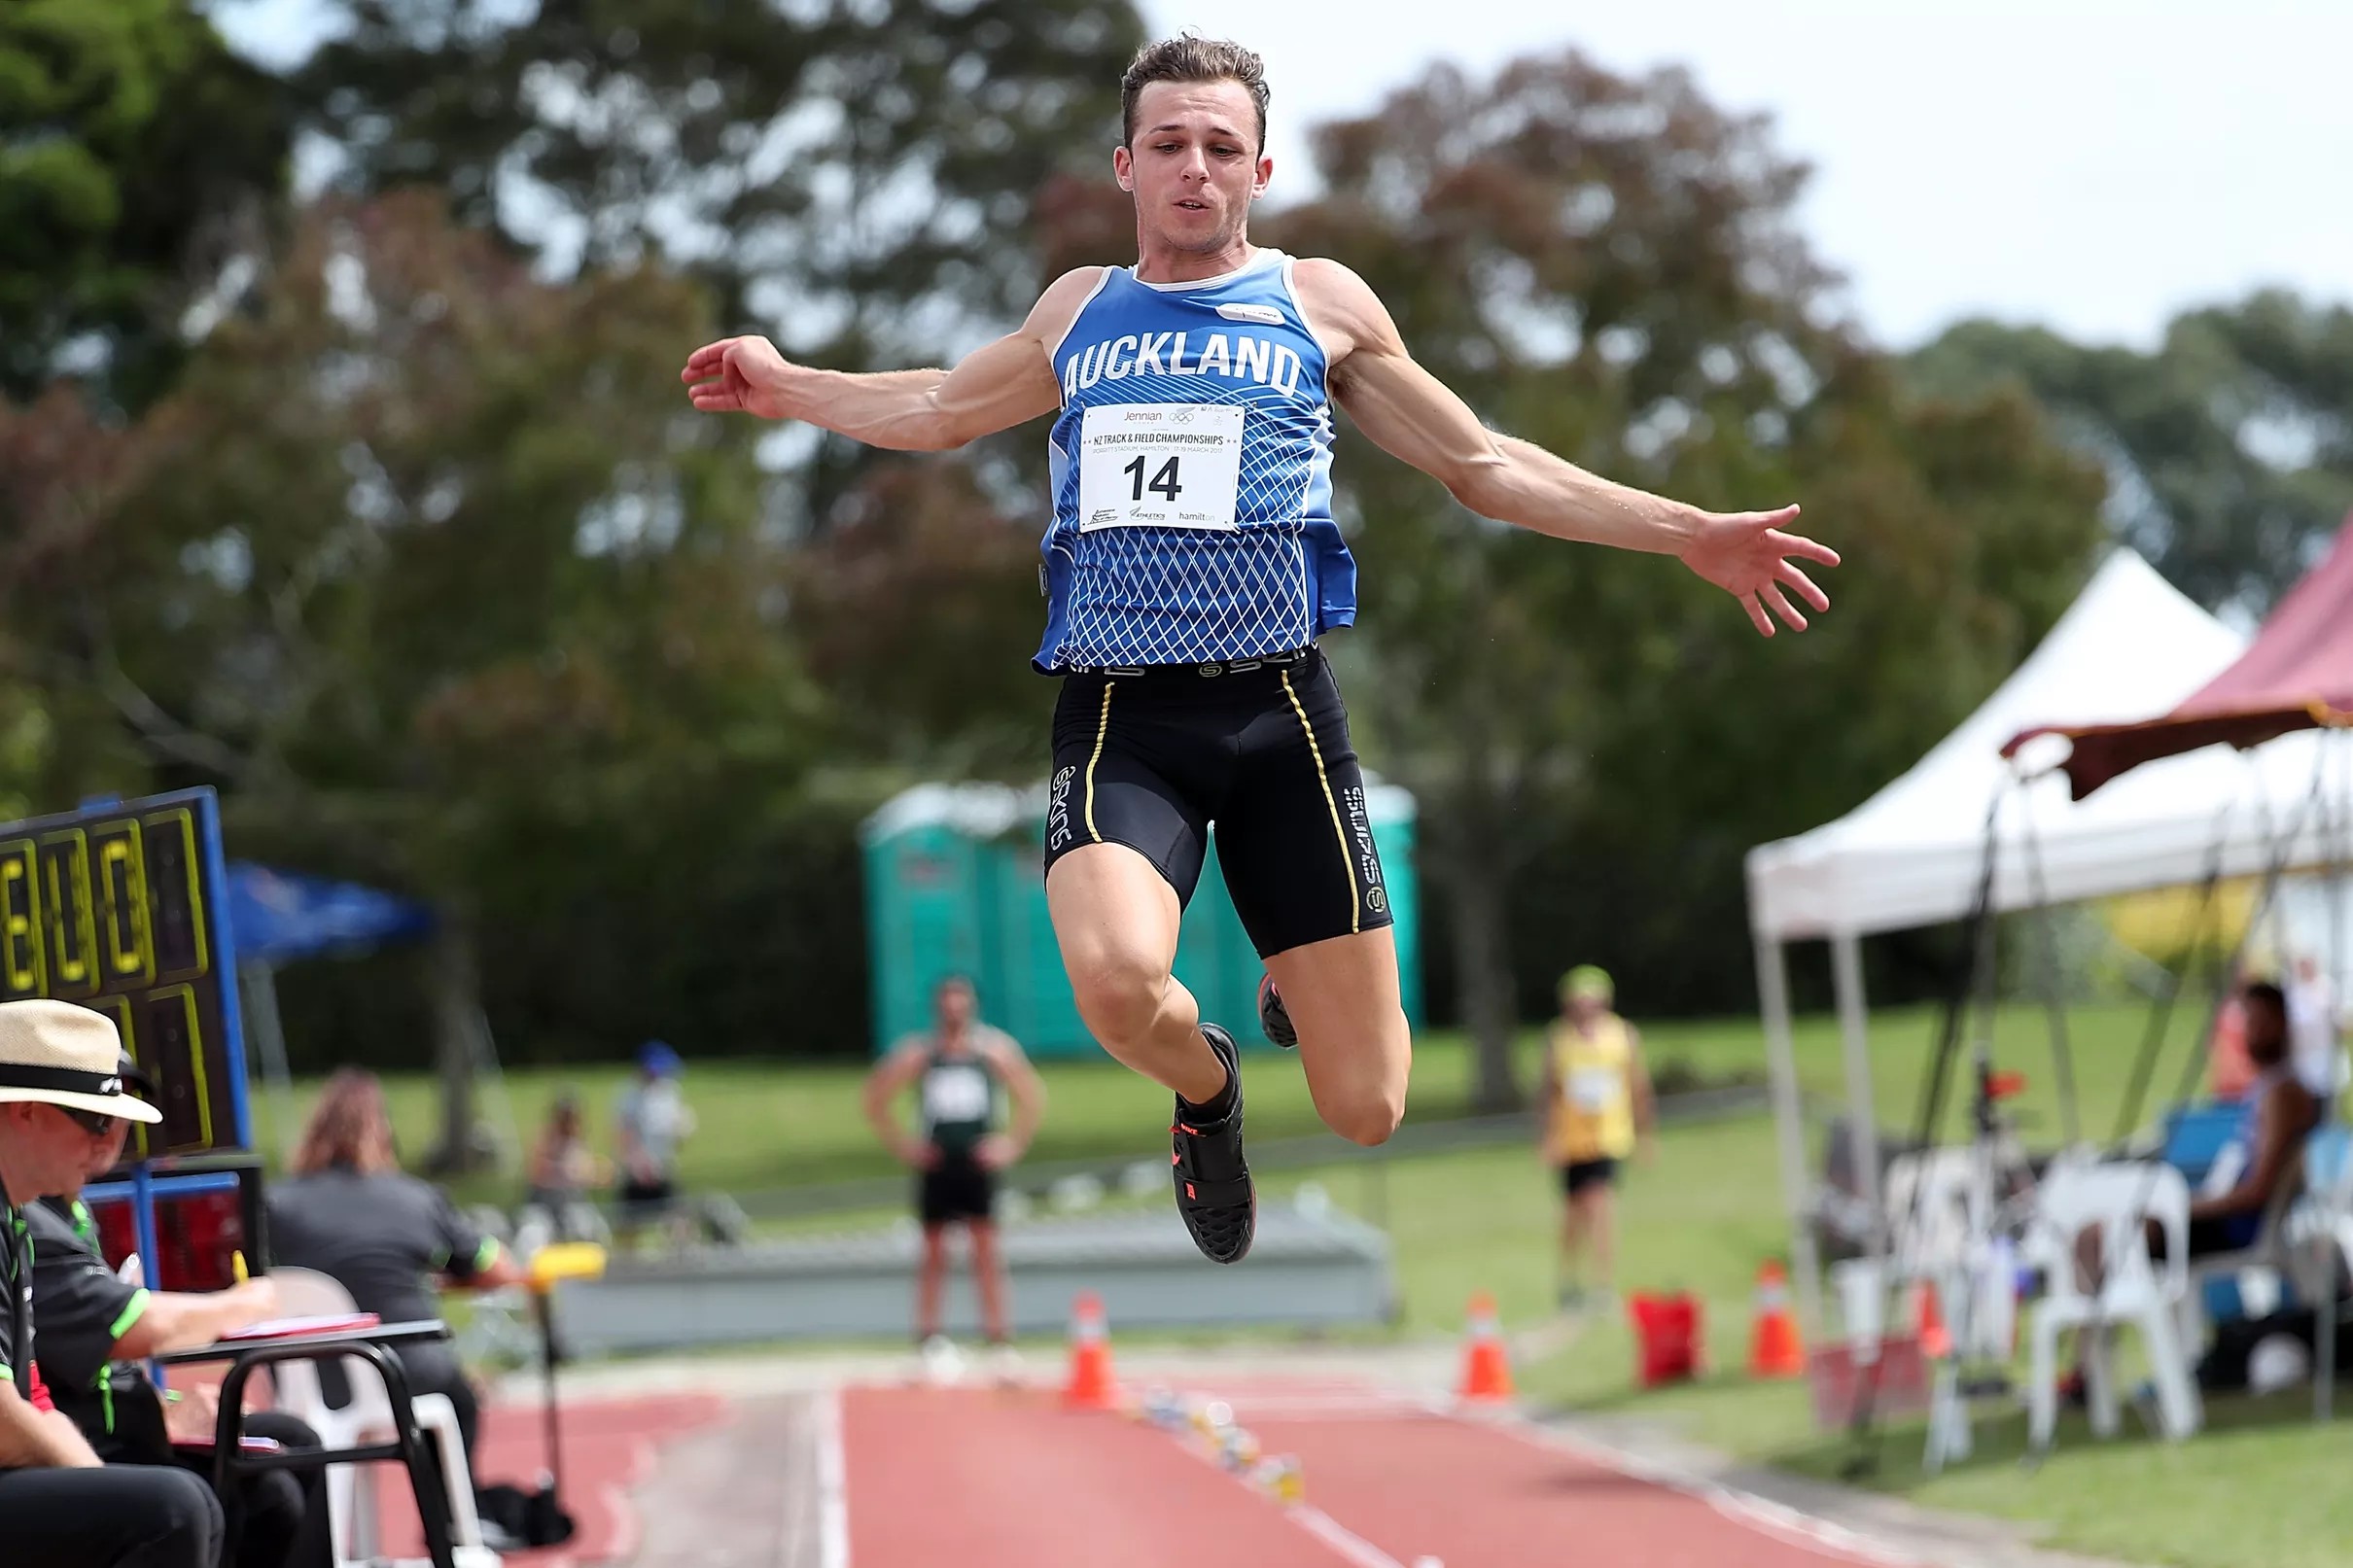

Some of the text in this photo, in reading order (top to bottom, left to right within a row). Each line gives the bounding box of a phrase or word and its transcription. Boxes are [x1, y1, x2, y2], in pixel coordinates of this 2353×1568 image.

[1064, 331, 1302, 400] AUCKLAND
[1123, 411, 1163, 422] Jennian
[1093, 433, 1224, 446] NZ TRACK & FIELD CHAMPIONSHIPS
[1124, 455, 1182, 502] 14
[1178, 511, 1215, 521] hamilton
[1343, 786, 1381, 885] SKINS
